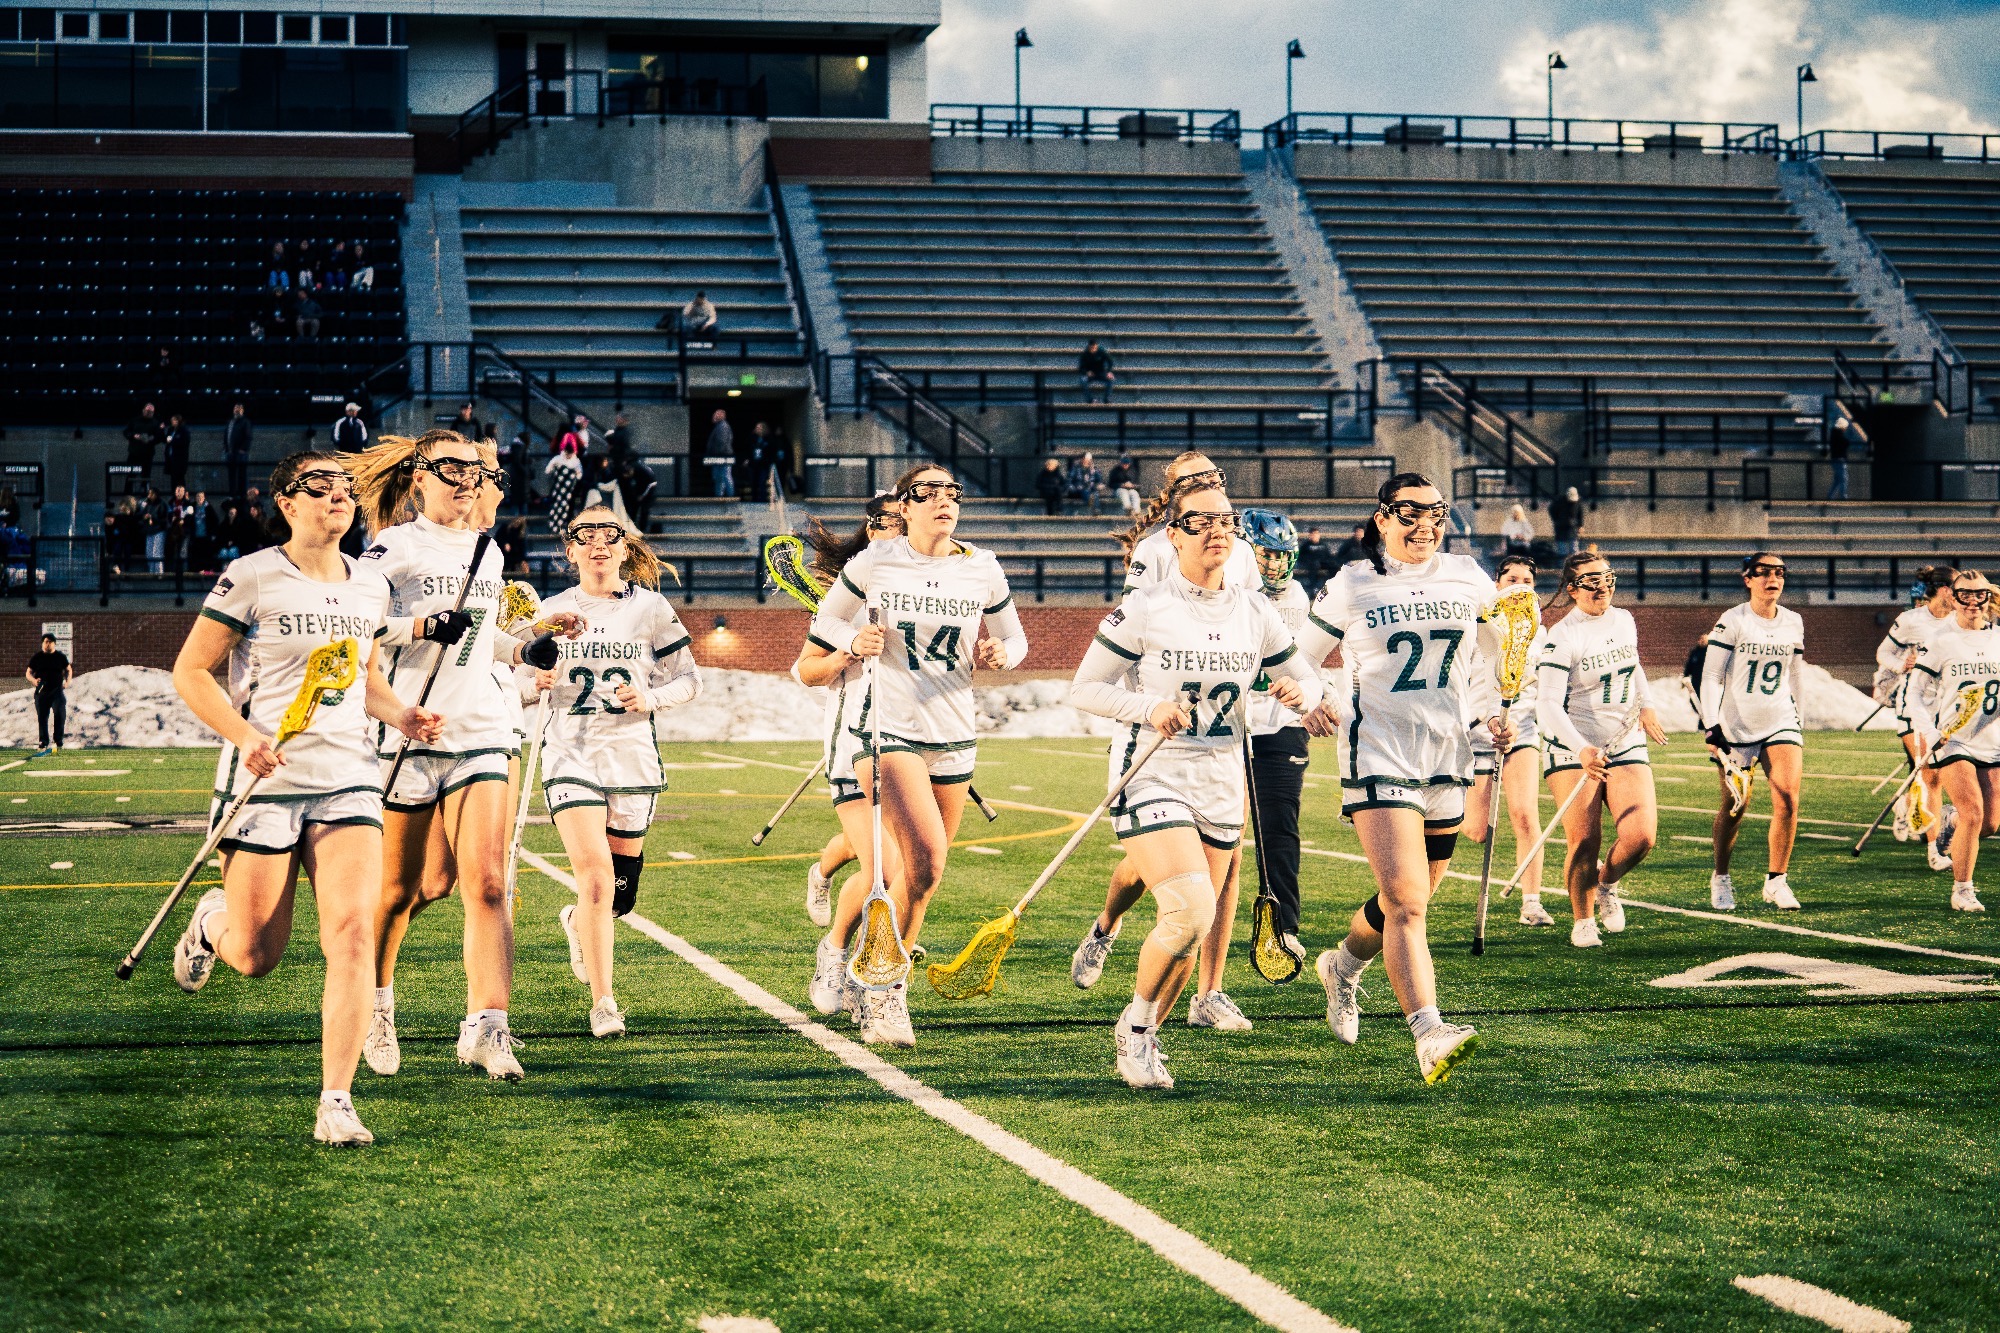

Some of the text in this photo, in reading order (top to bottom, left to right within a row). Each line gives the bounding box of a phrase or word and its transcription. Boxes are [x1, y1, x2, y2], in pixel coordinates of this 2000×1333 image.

[880, 591, 980, 618] STEVENSON
[1365, 600, 1472, 629] STEVENSON
[455, 607, 488, 667] 7
[558, 641, 642, 660] STEVENSON
[896, 620, 961, 671] 14
[1160, 649, 1257, 673] STEVENSON
[1386, 629, 1465, 692] 27
[1746, 660, 1782, 695] 19
[567, 666, 632, 716] 23
[1600, 664, 1637, 704] 17
